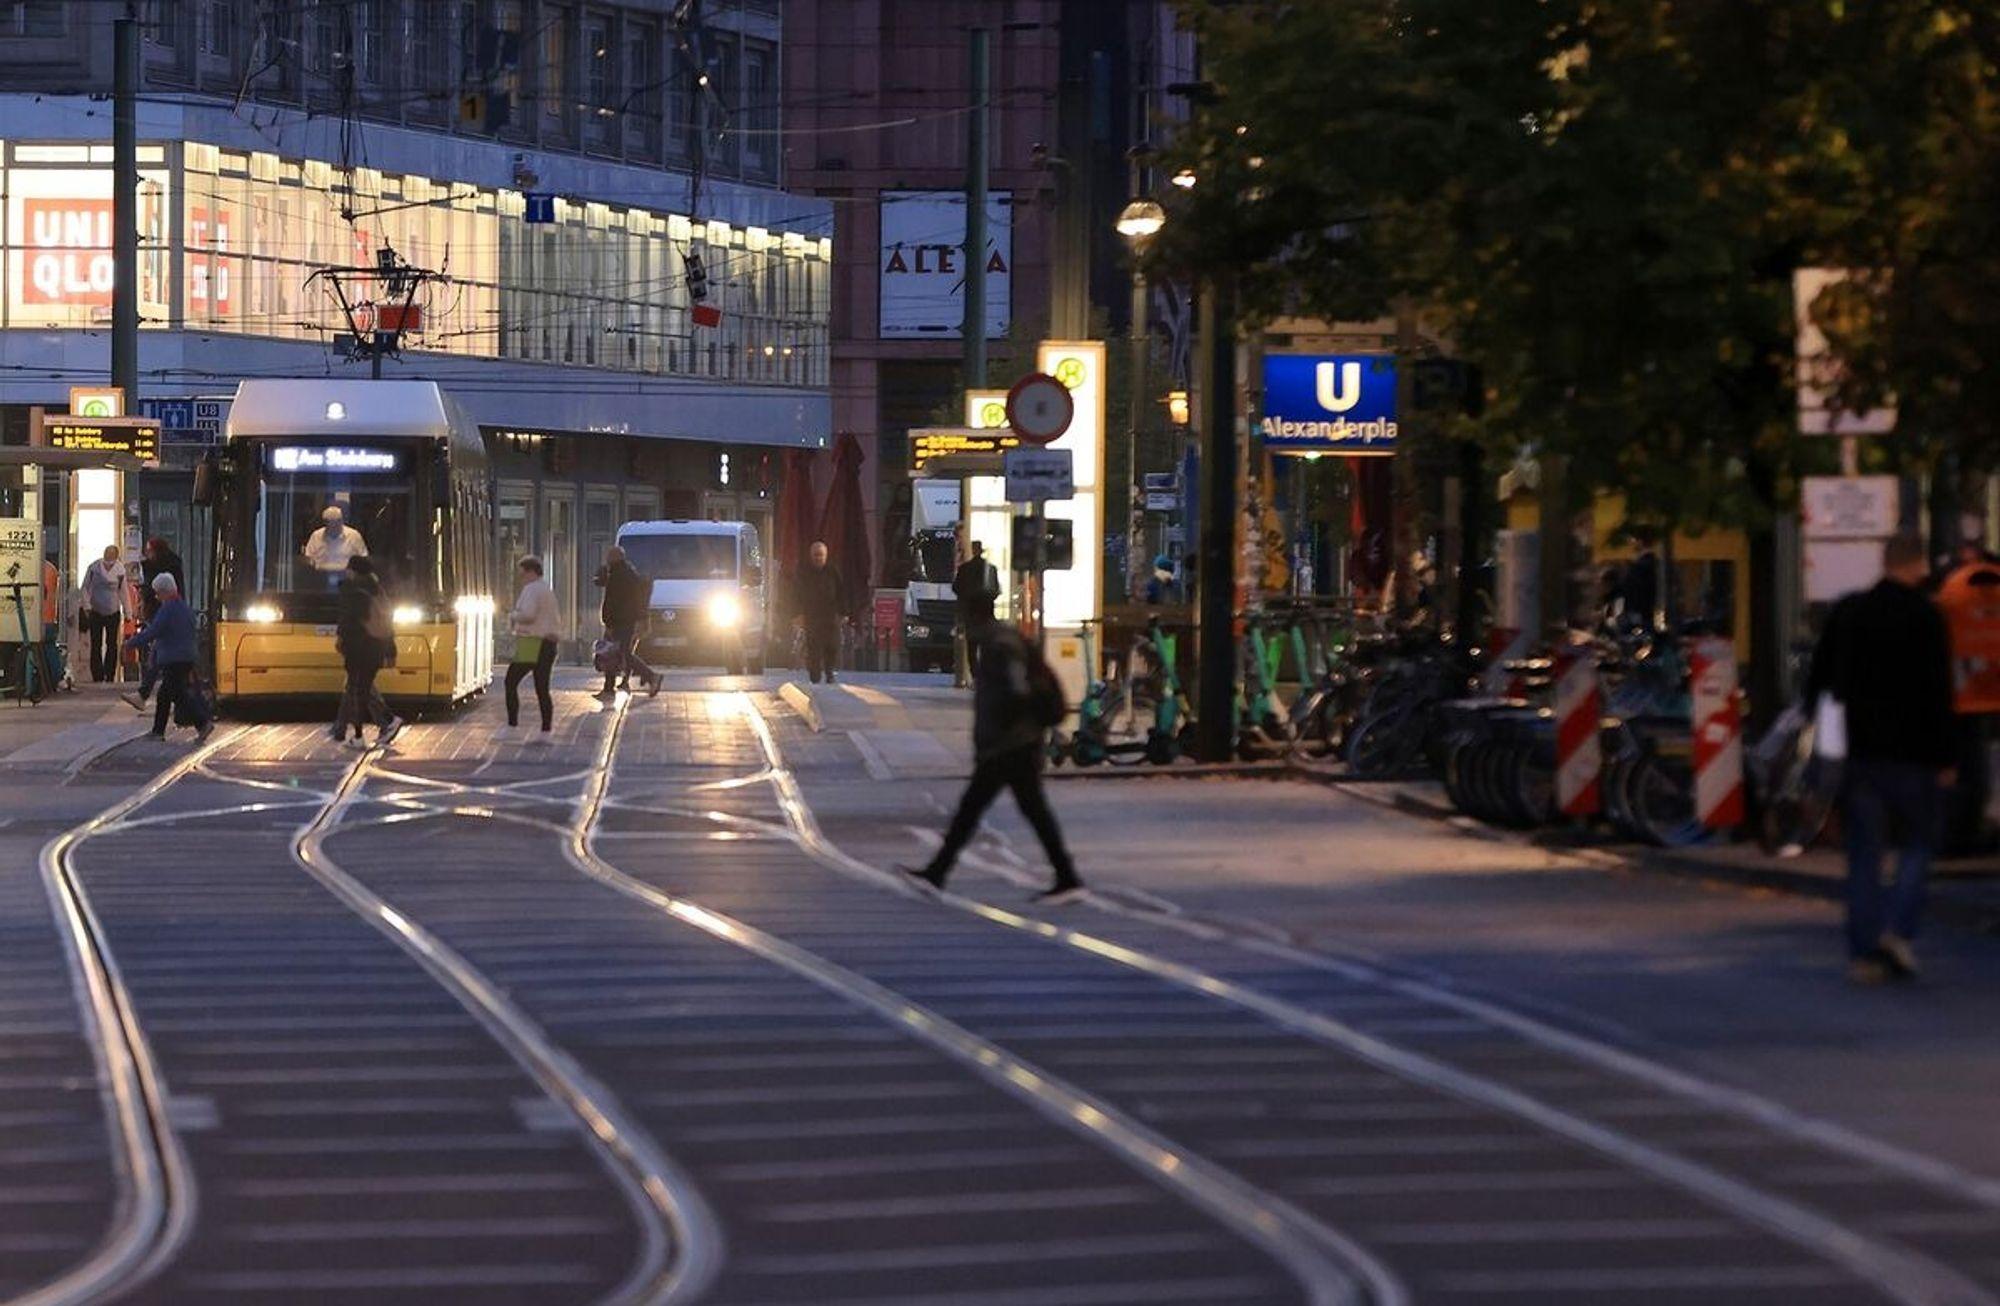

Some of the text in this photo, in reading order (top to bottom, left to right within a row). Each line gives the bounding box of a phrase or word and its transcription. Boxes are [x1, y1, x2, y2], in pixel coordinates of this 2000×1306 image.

[33, 210, 110, 248] UNI
[32, 253, 114, 299] QLO
[885, 246, 1008, 273] ALEA
[1316, 362, 1361, 412] U
